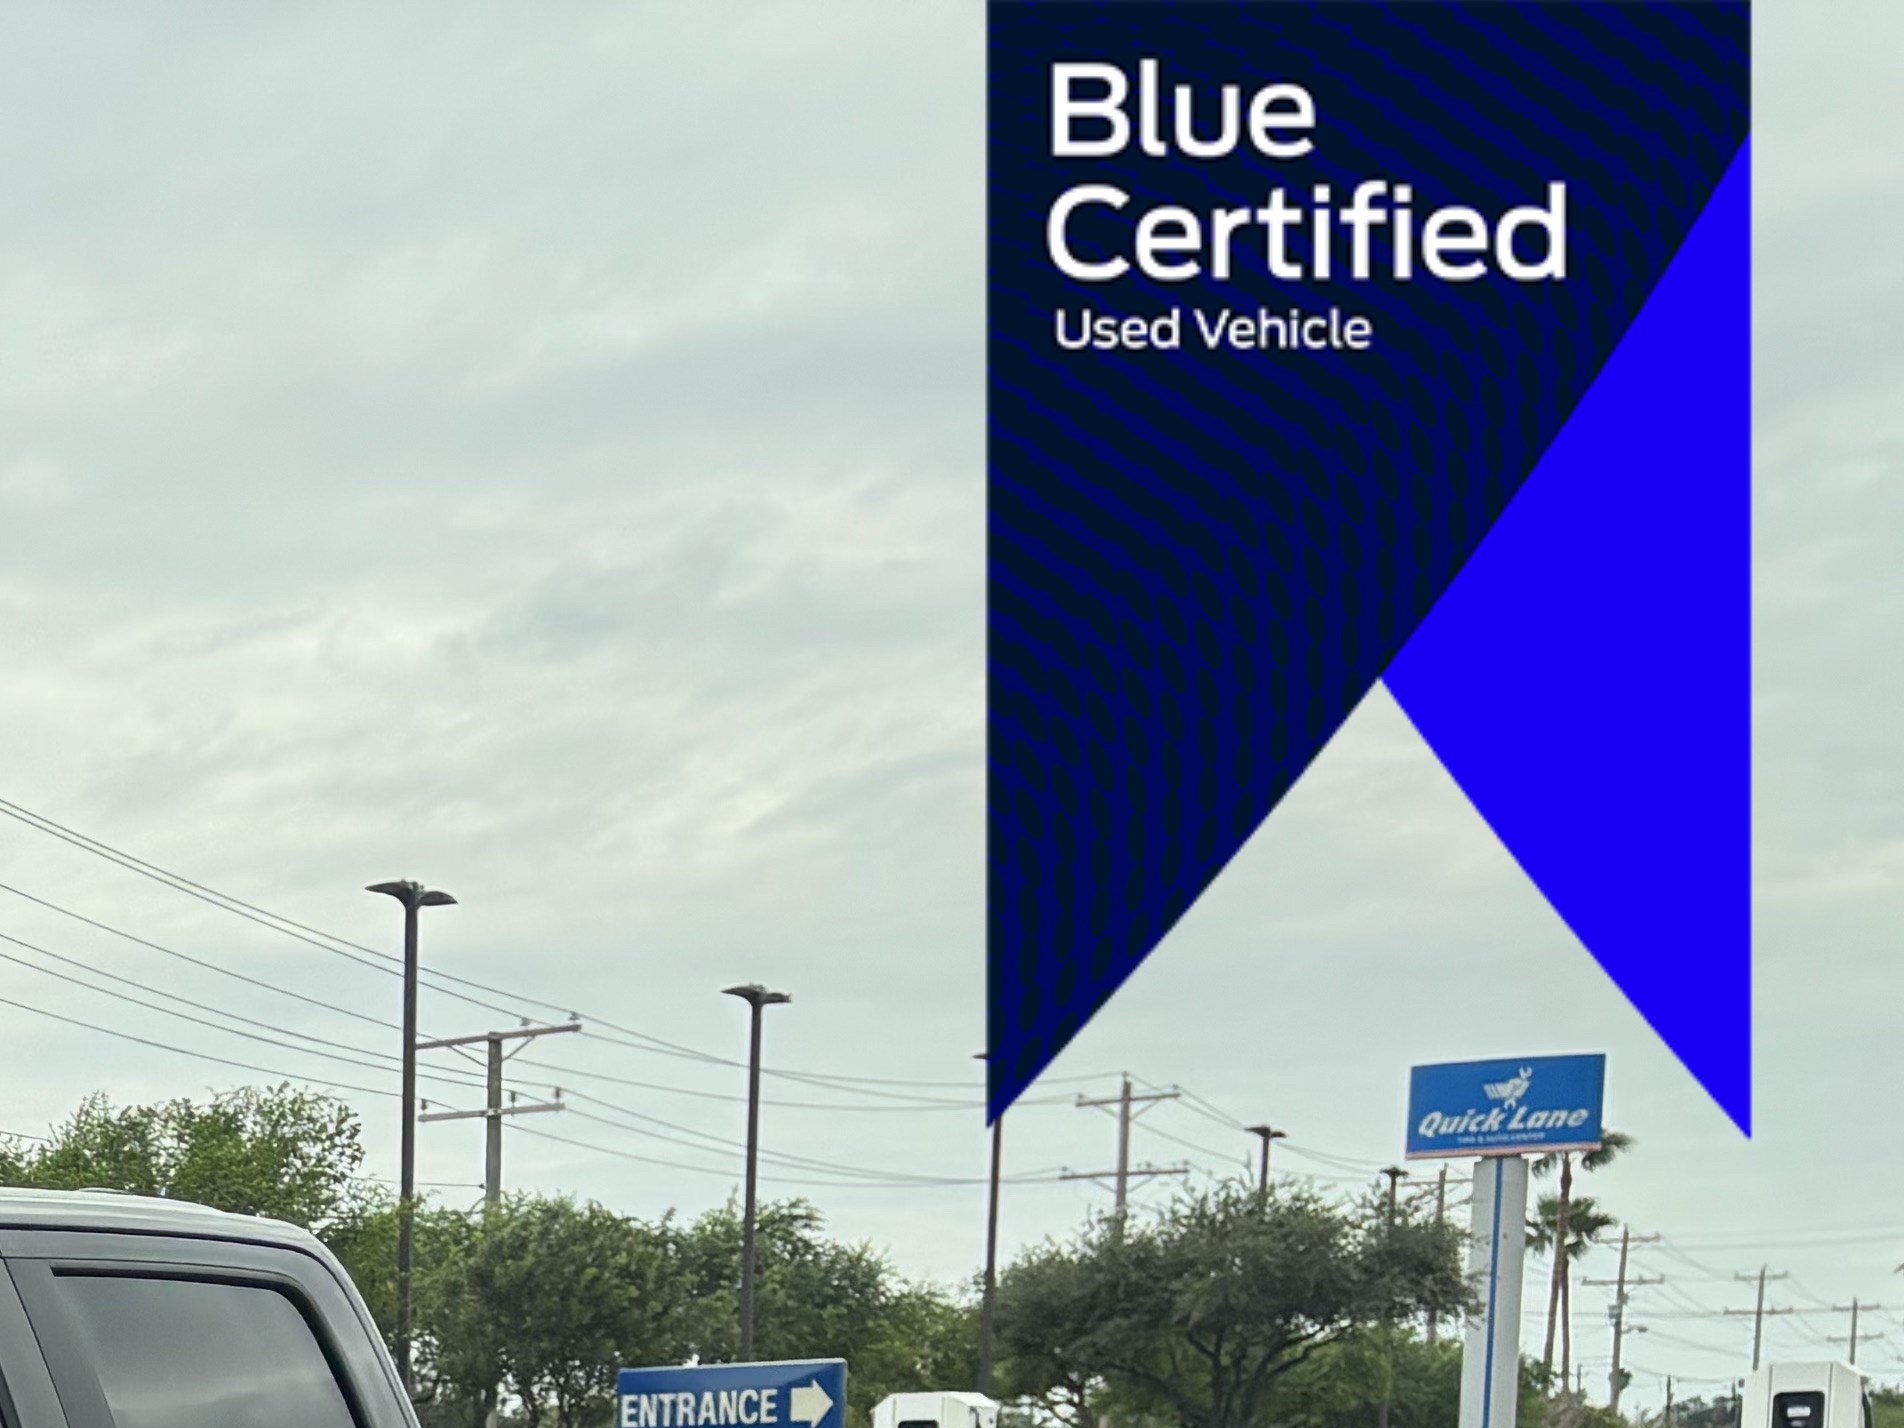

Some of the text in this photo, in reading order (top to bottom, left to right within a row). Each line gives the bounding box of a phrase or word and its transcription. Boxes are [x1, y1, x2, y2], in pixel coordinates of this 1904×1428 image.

[1418, 1107, 1507, 1138] Quick
[1507, 1105, 1590, 1131] Lane
[620, 1388, 778, 1428] ENTRANCE
